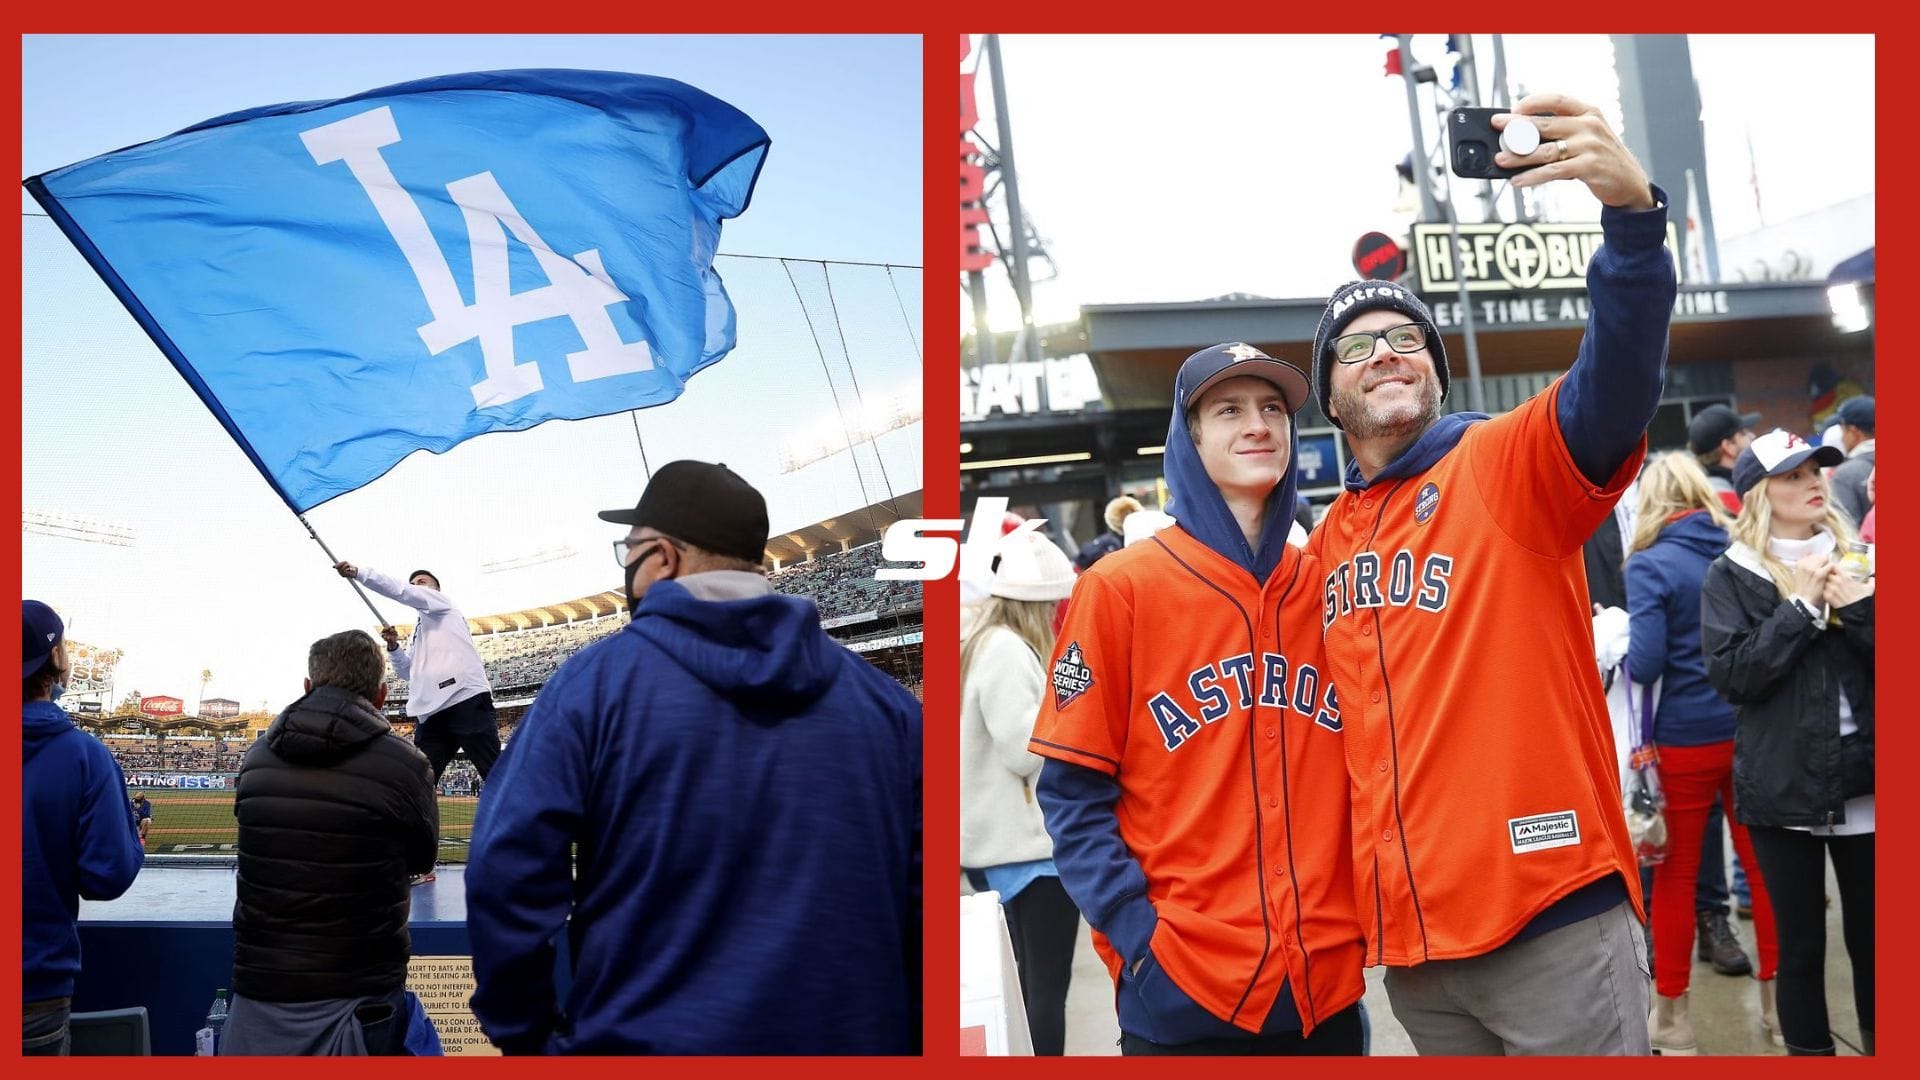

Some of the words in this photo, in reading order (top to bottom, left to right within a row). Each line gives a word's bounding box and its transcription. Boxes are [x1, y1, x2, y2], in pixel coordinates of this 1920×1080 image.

[300, 105, 655, 410] LA
[1546, 233, 1603, 278] BU
[1333, 287, 1405, 320] Astros
[1482, 299, 1548, 324] TIME
[1559, 298, 1589, 320] AL
[1323, 548, 1454, 630] STROS
[1053, 674, 1086, 692] SERIES
[1055, 660, 1090, 681] WORLD
[1146, 652, 1344, 752] ASTROS
[1532, 821, 1569, 833] Majestic
